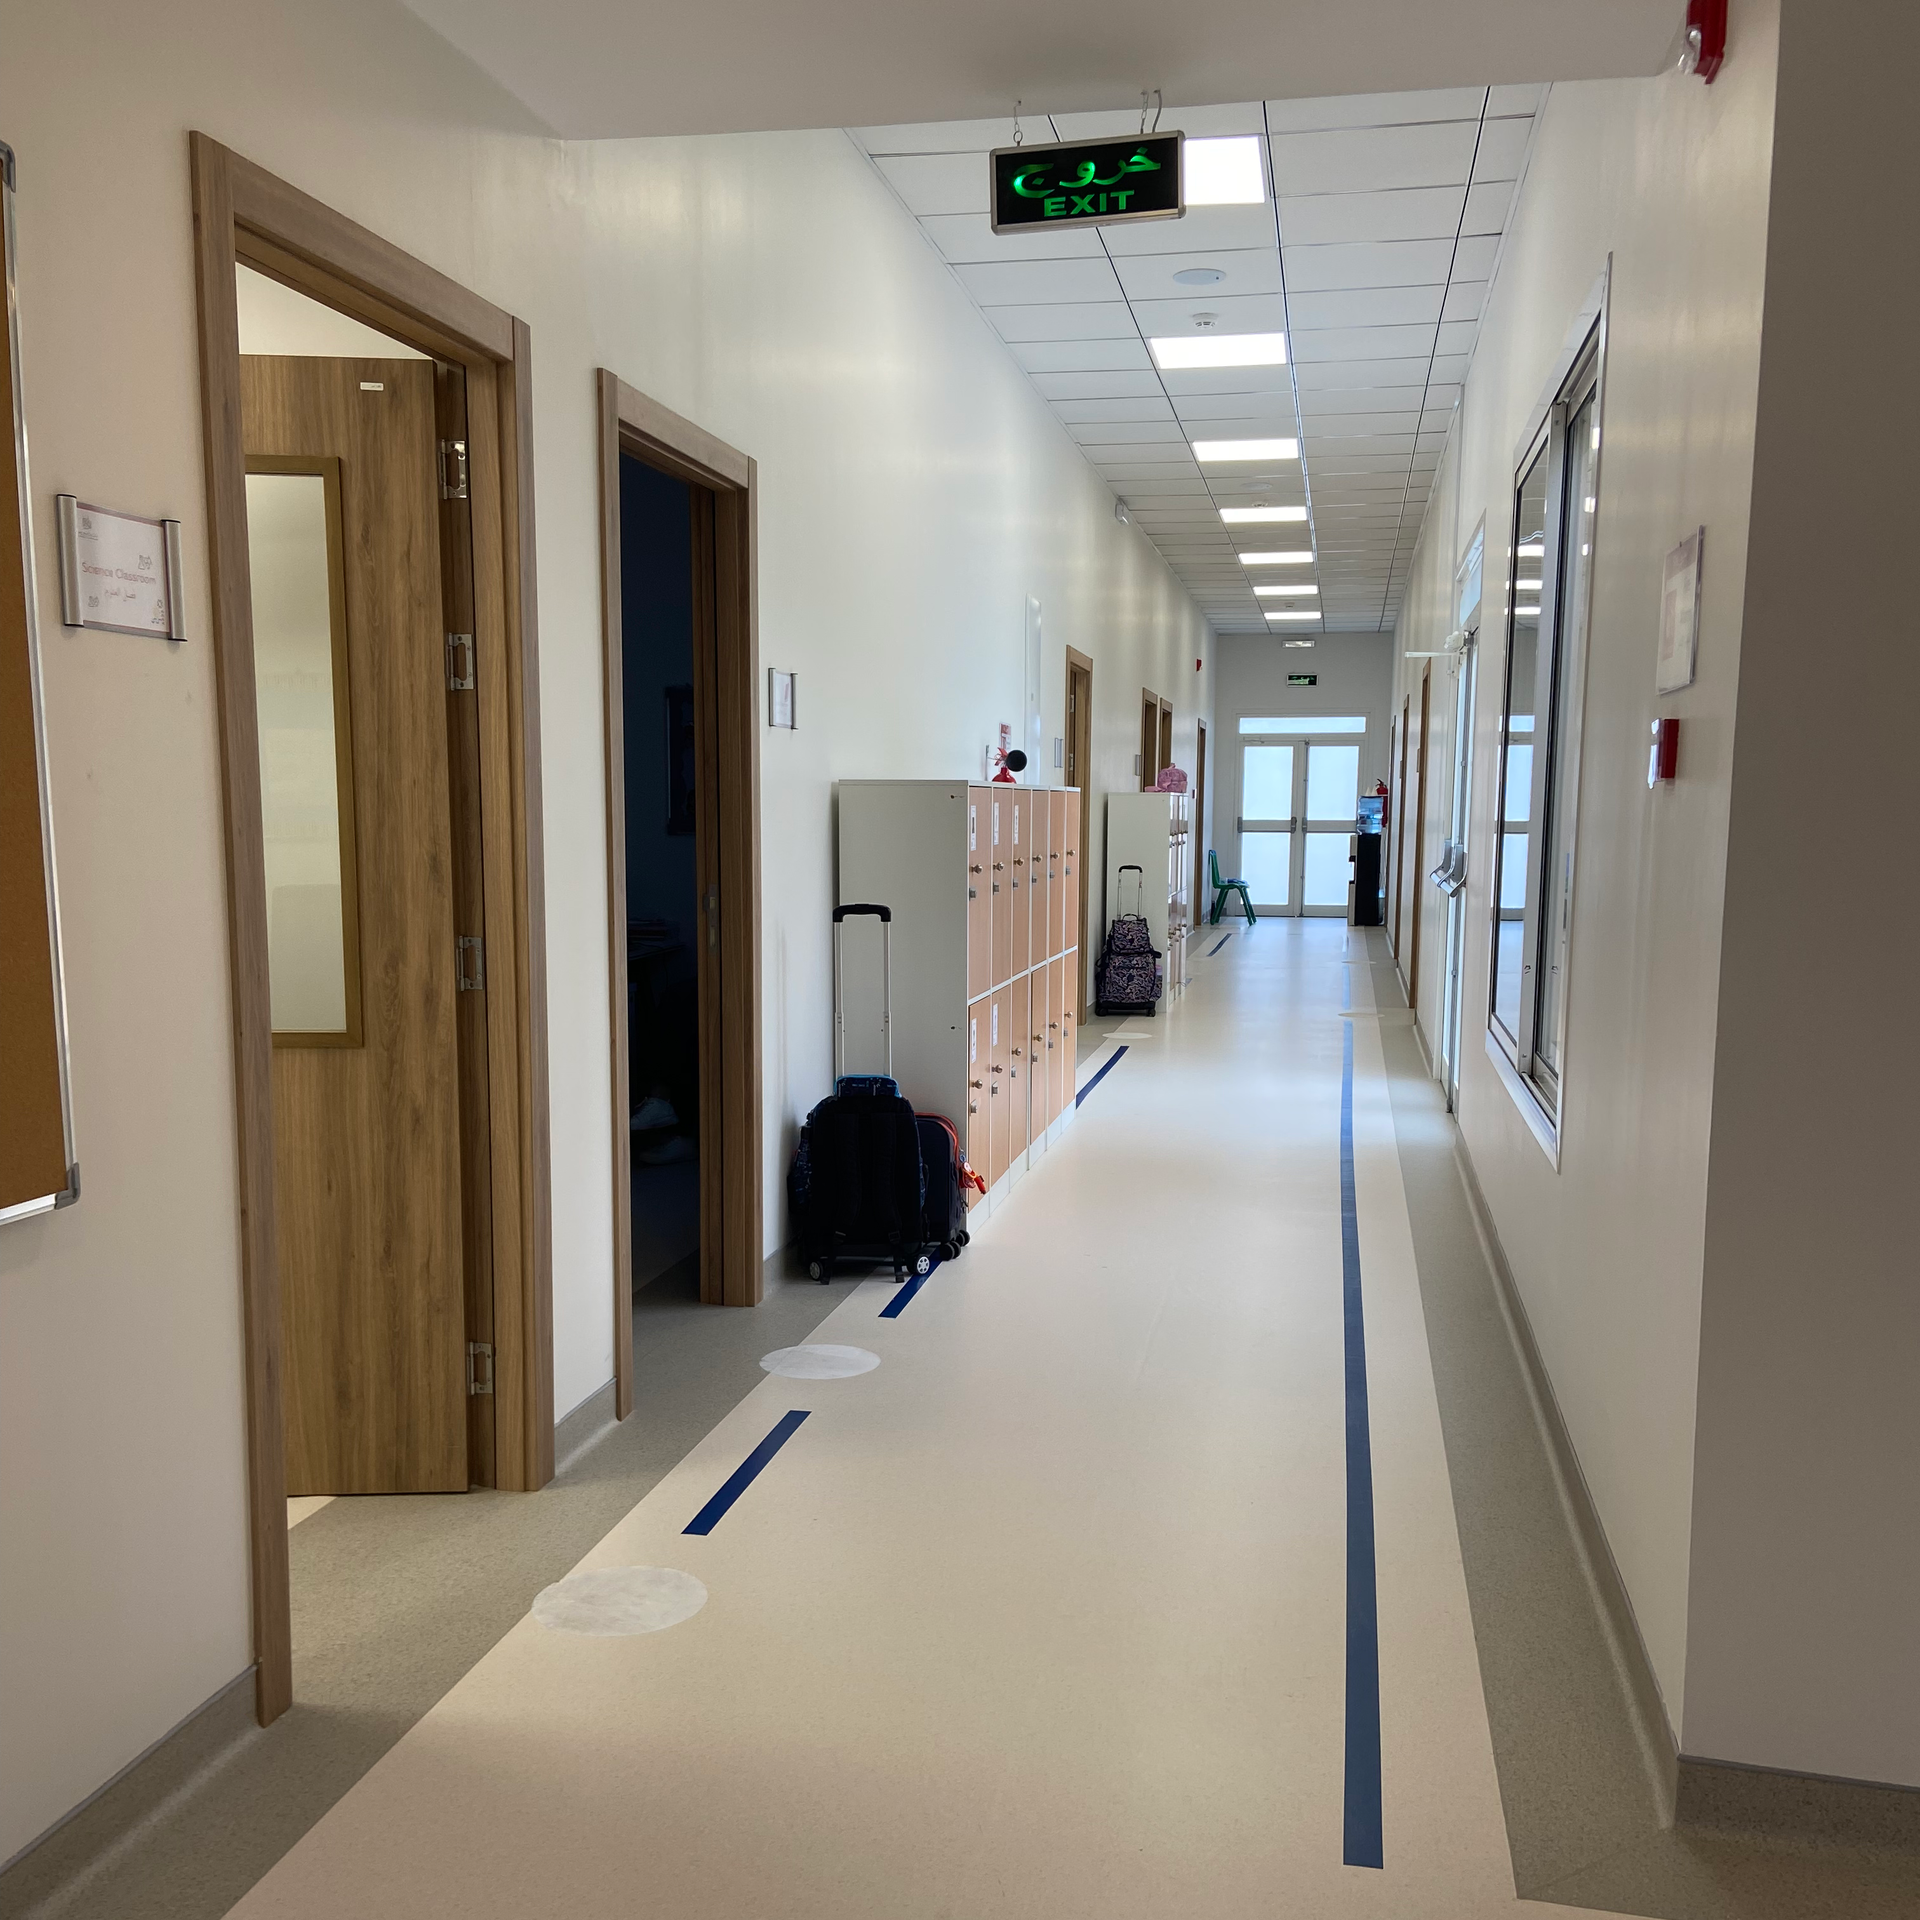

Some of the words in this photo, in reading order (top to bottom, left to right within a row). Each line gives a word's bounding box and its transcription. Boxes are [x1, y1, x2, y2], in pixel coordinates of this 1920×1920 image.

[1013, 147, 1161, 198] خروج
[1044, 190, 1135, 217] EXIT
[82, 562, 113, 578] Science
[115, 569, 156, 585] Classroom
